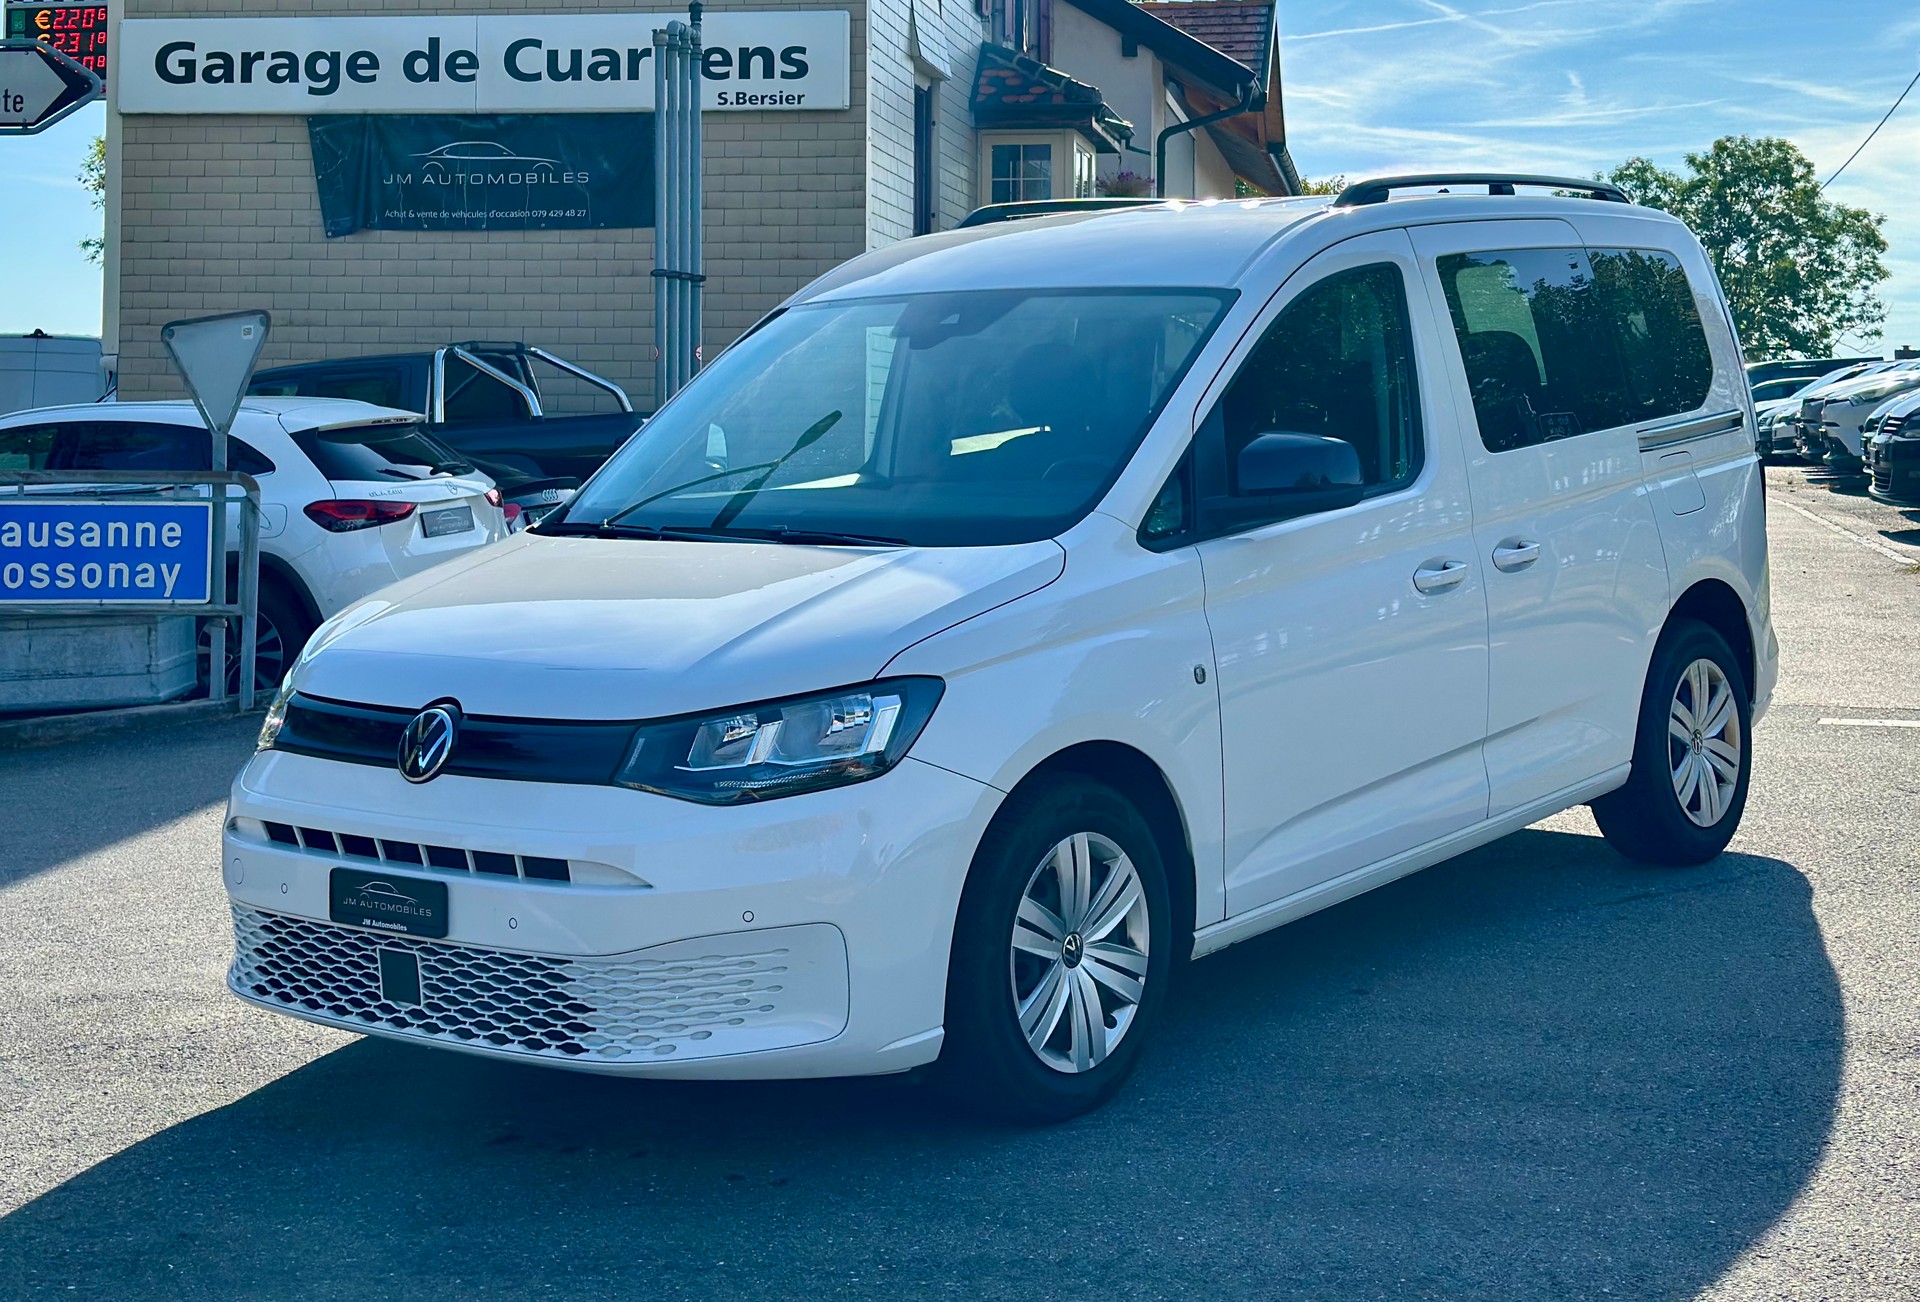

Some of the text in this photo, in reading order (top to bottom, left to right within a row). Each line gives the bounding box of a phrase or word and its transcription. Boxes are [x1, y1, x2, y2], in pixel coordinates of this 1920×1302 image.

[154, 37, 809, 96] Garage de Cuarens
[717, 90, 806, 106] S.Bersier
[383, 172, 589, 185] JM AUTOMOBILES
[384, 209, 407, 218] Achat
[408, 210, 415, 218] &
[439, 209, 450, 218] de
[451, 209, 487, 218] véhicules
[489, 209, 530, 218] d'occasion
[531, 209, 547, 218] 079
[548, 209, 564, 218] 429
[565, 209, 576, 218] 48
[576, 209, 587, 217] 27
[1, 521, 182, 548] ausanne
[3, 562, 181, 598] ossonay
[343, 898, 432, 917] JM AUTOMOBILES
[362, 918, 408, 932] JM Automobiles
